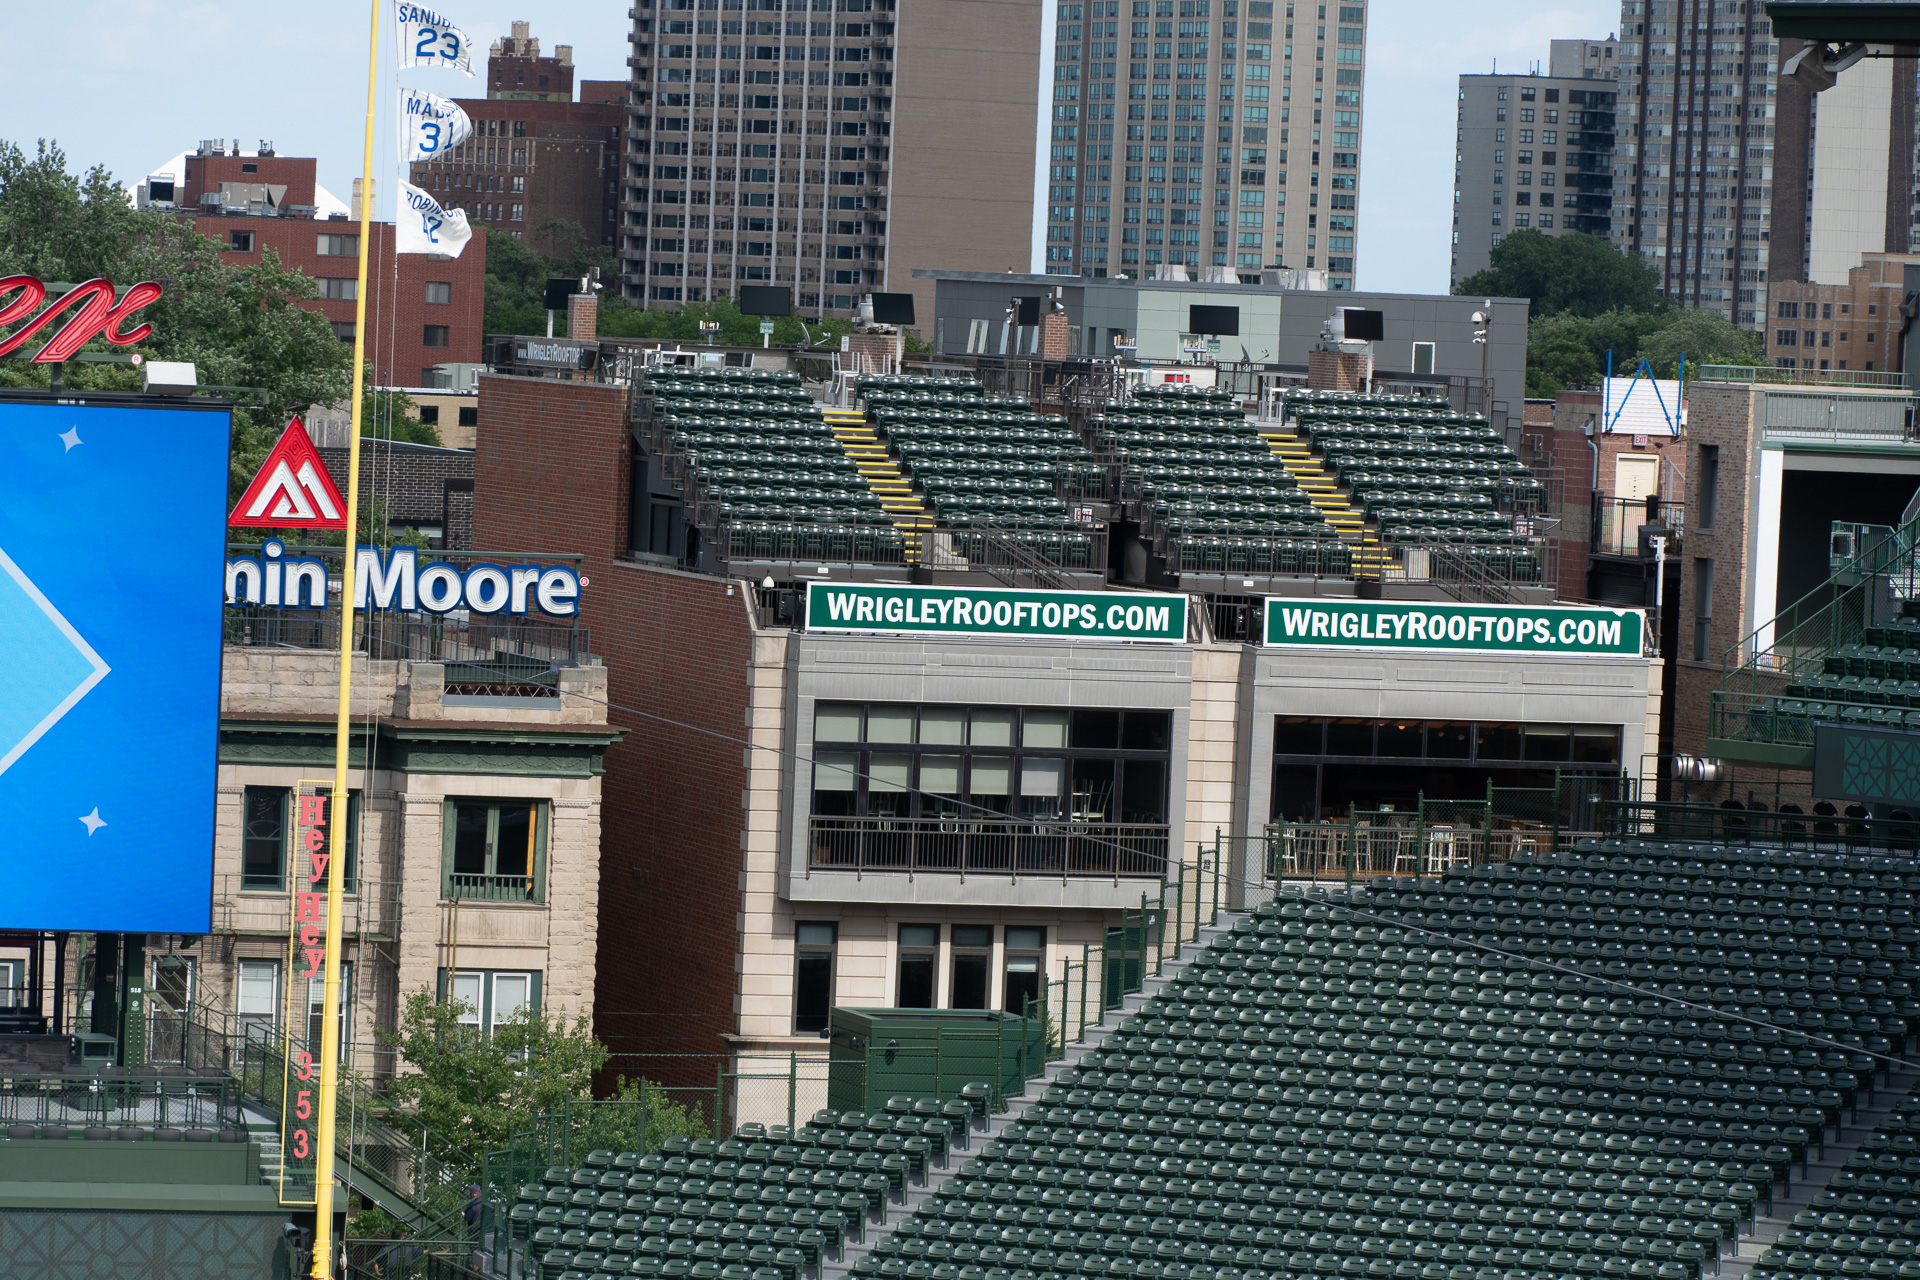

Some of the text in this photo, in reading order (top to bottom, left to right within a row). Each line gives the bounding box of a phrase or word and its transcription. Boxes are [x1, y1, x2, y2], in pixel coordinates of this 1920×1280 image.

[416, 28, 460, 60] 23
[419, 121, 454, 153] 31
[406, 191, 464, 219] ROBINON
[422, 214, 443, 244] 42
[1635, 436, 1646, 444] EXIT
[353, 549, 579, 614] Moore
[826, 591, 1170, 632] WRIGLEYROOFTOPS.COM
[1282, 607, 1622, 646] WRIGLEYROOFTOPS.COM
[298, 796, 330, 882] Hey
[294, 892, 326, 978] Hey
[293, 1051, 312, 1159] 353
